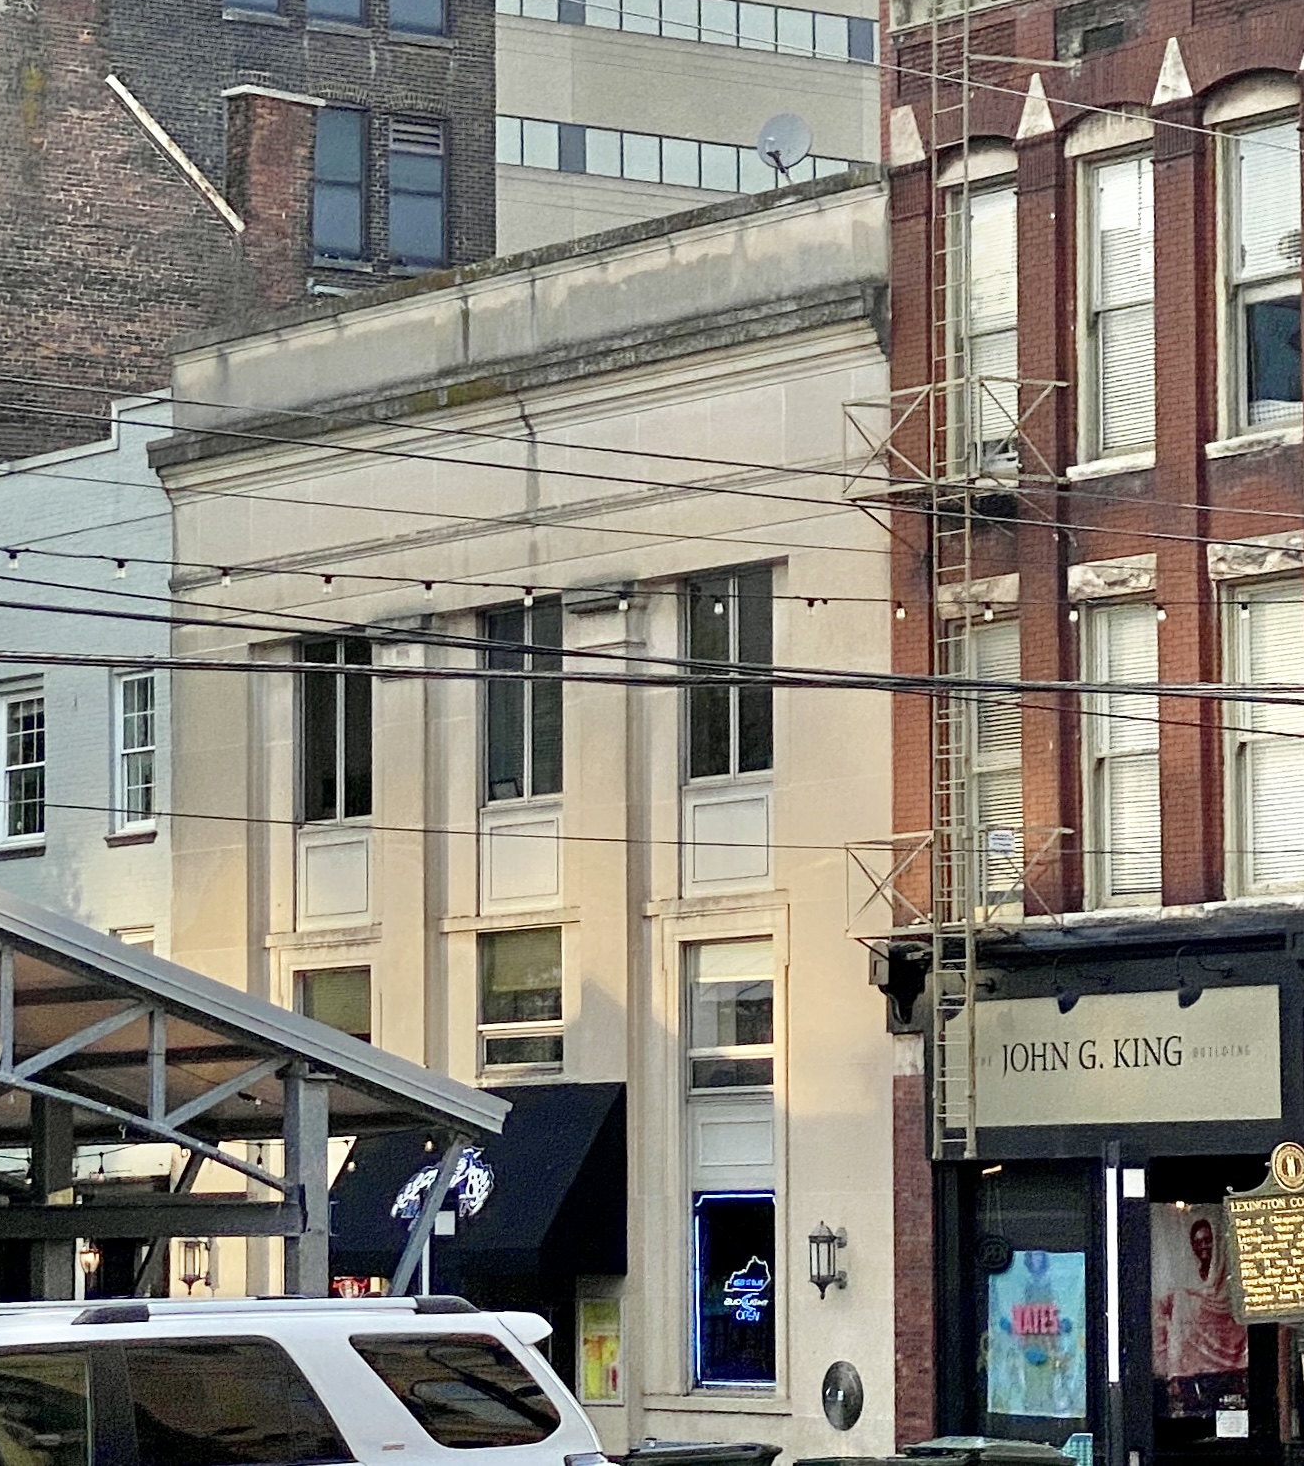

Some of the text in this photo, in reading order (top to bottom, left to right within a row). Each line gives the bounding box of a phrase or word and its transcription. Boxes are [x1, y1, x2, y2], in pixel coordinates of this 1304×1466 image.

[1001, 1041, 1070, 1077] JOHN
[1078, 1040, 1104, 1070] G.
[1113, 1035, 1183, 1068] KING
[1230, 1197, 1286, 1212] LEXINGTON
